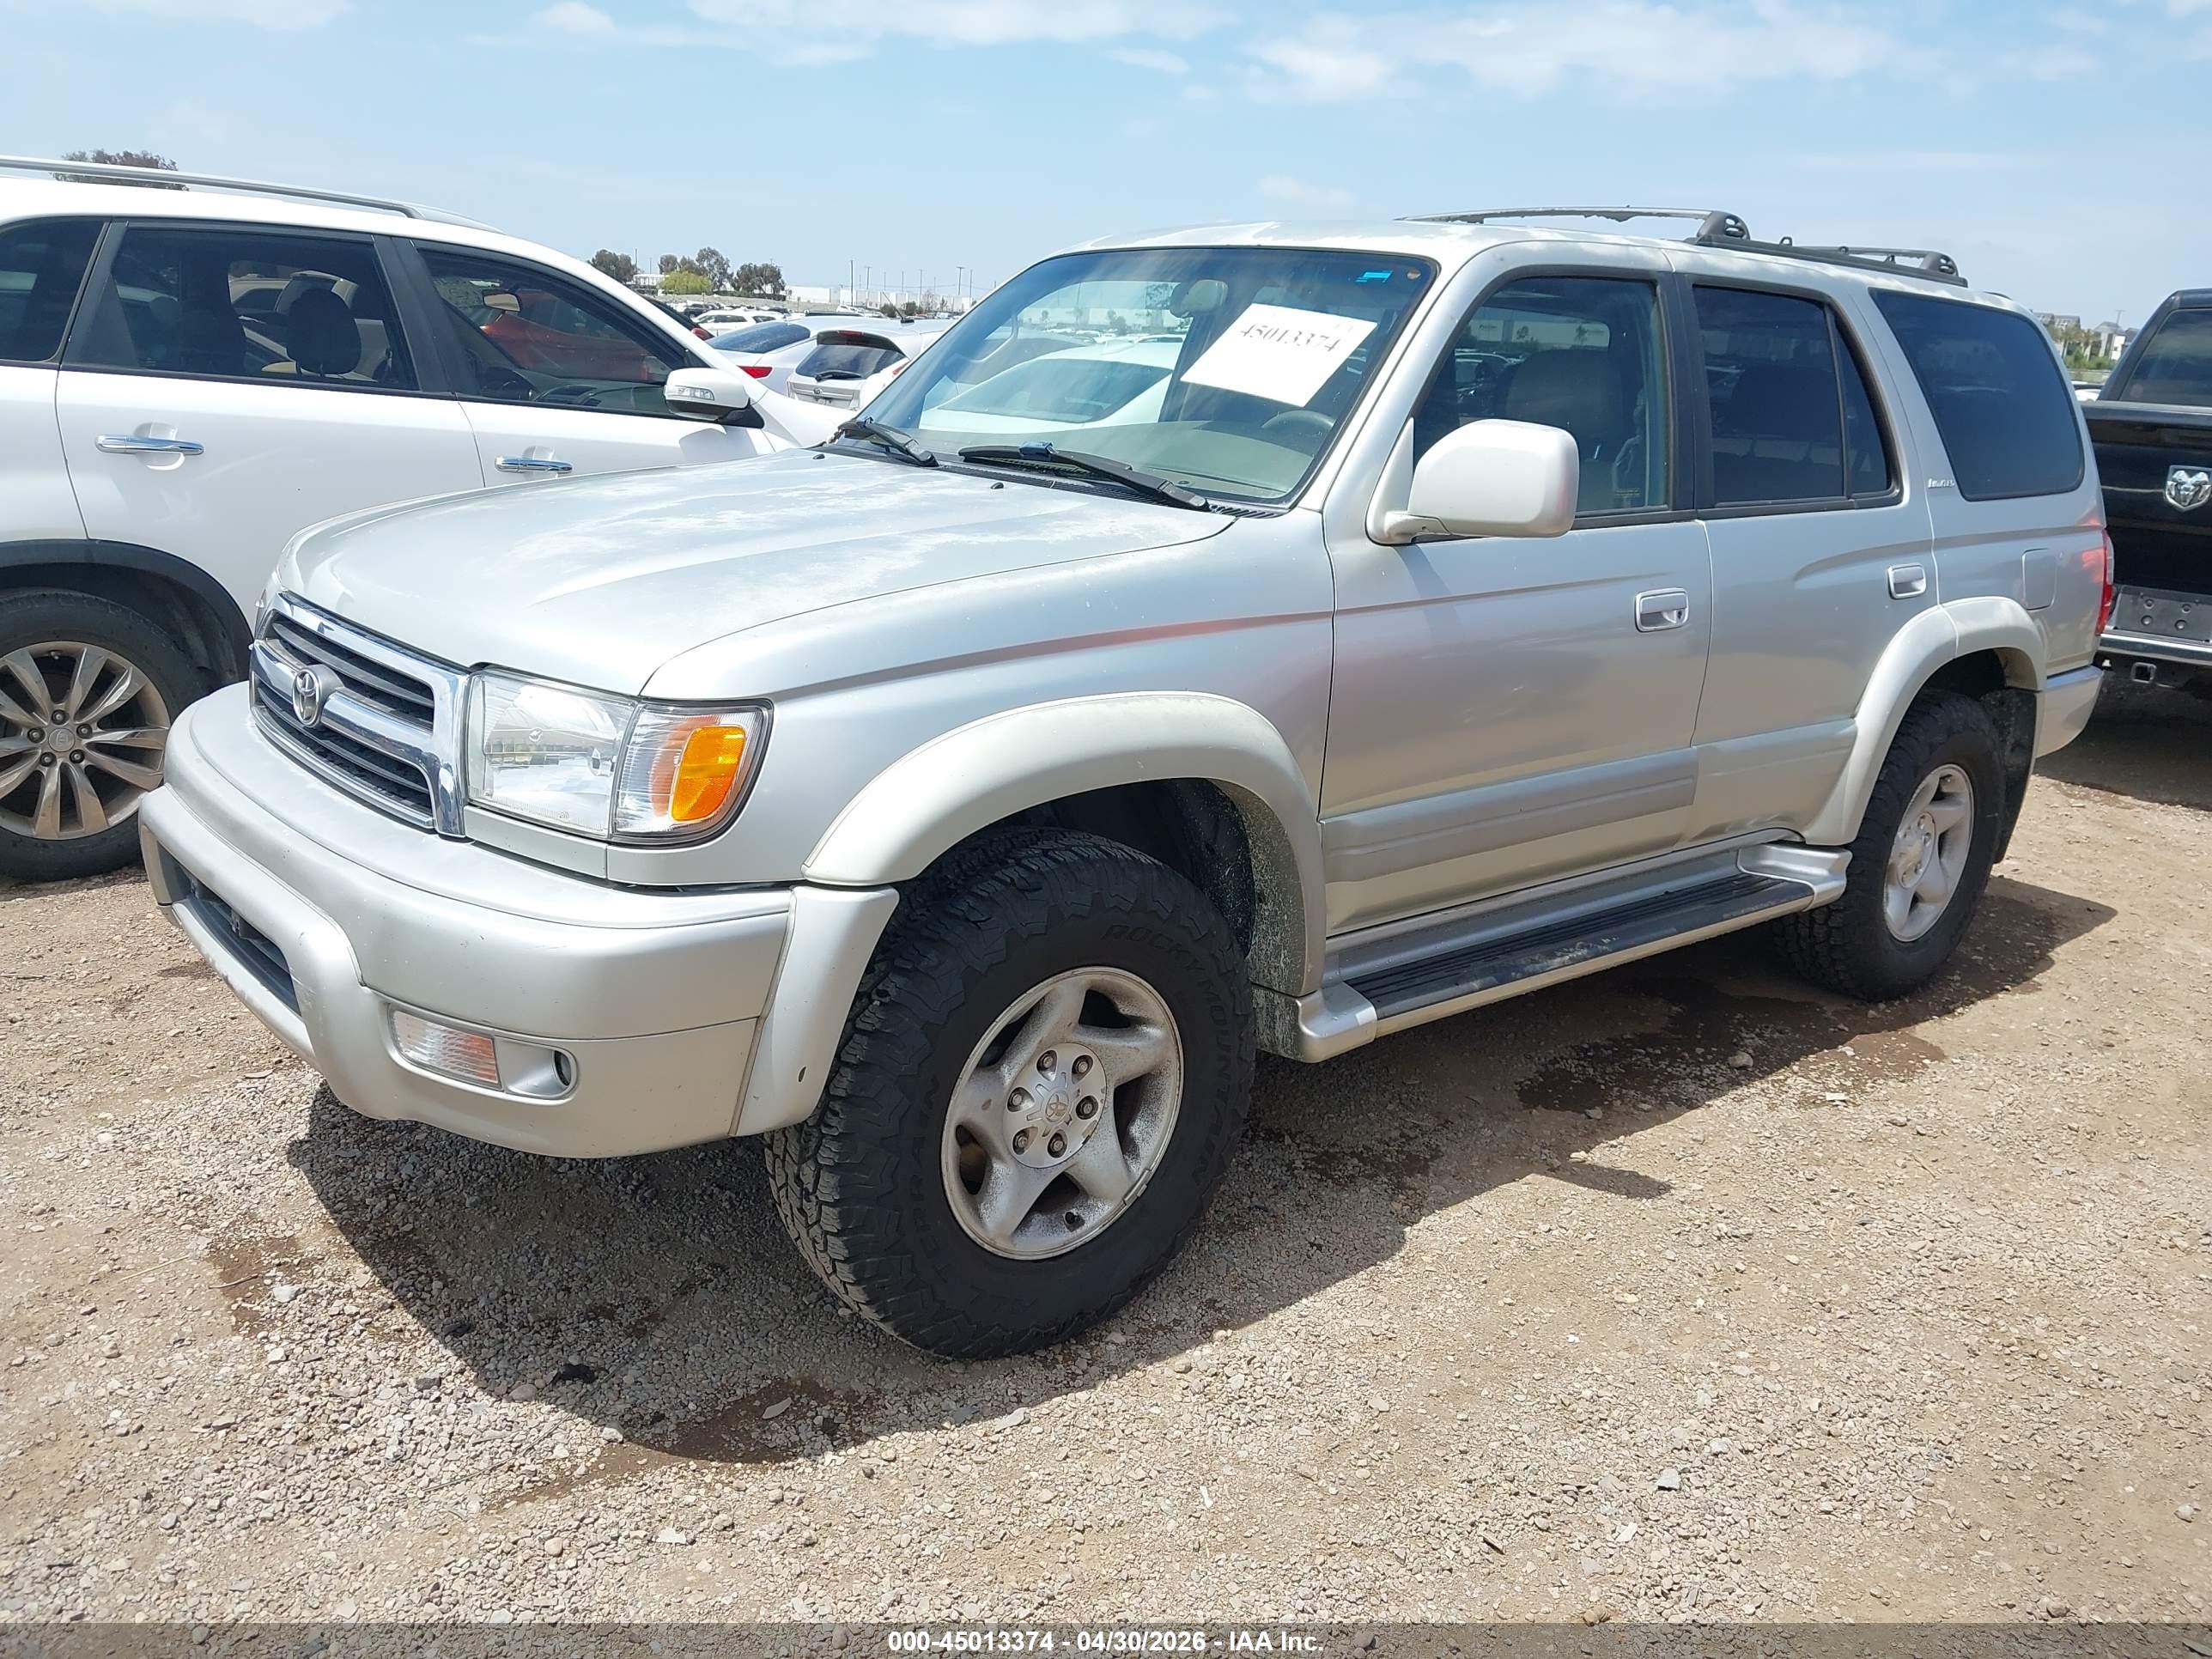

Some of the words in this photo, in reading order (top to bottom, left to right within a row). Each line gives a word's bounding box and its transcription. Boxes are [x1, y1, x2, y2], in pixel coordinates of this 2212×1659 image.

[1240, 323, 1342, 353] 45013374
[1100, 923, 1206, 974] ROCKY
[1192, 975, 1231, 1188] MOUNTAIN
